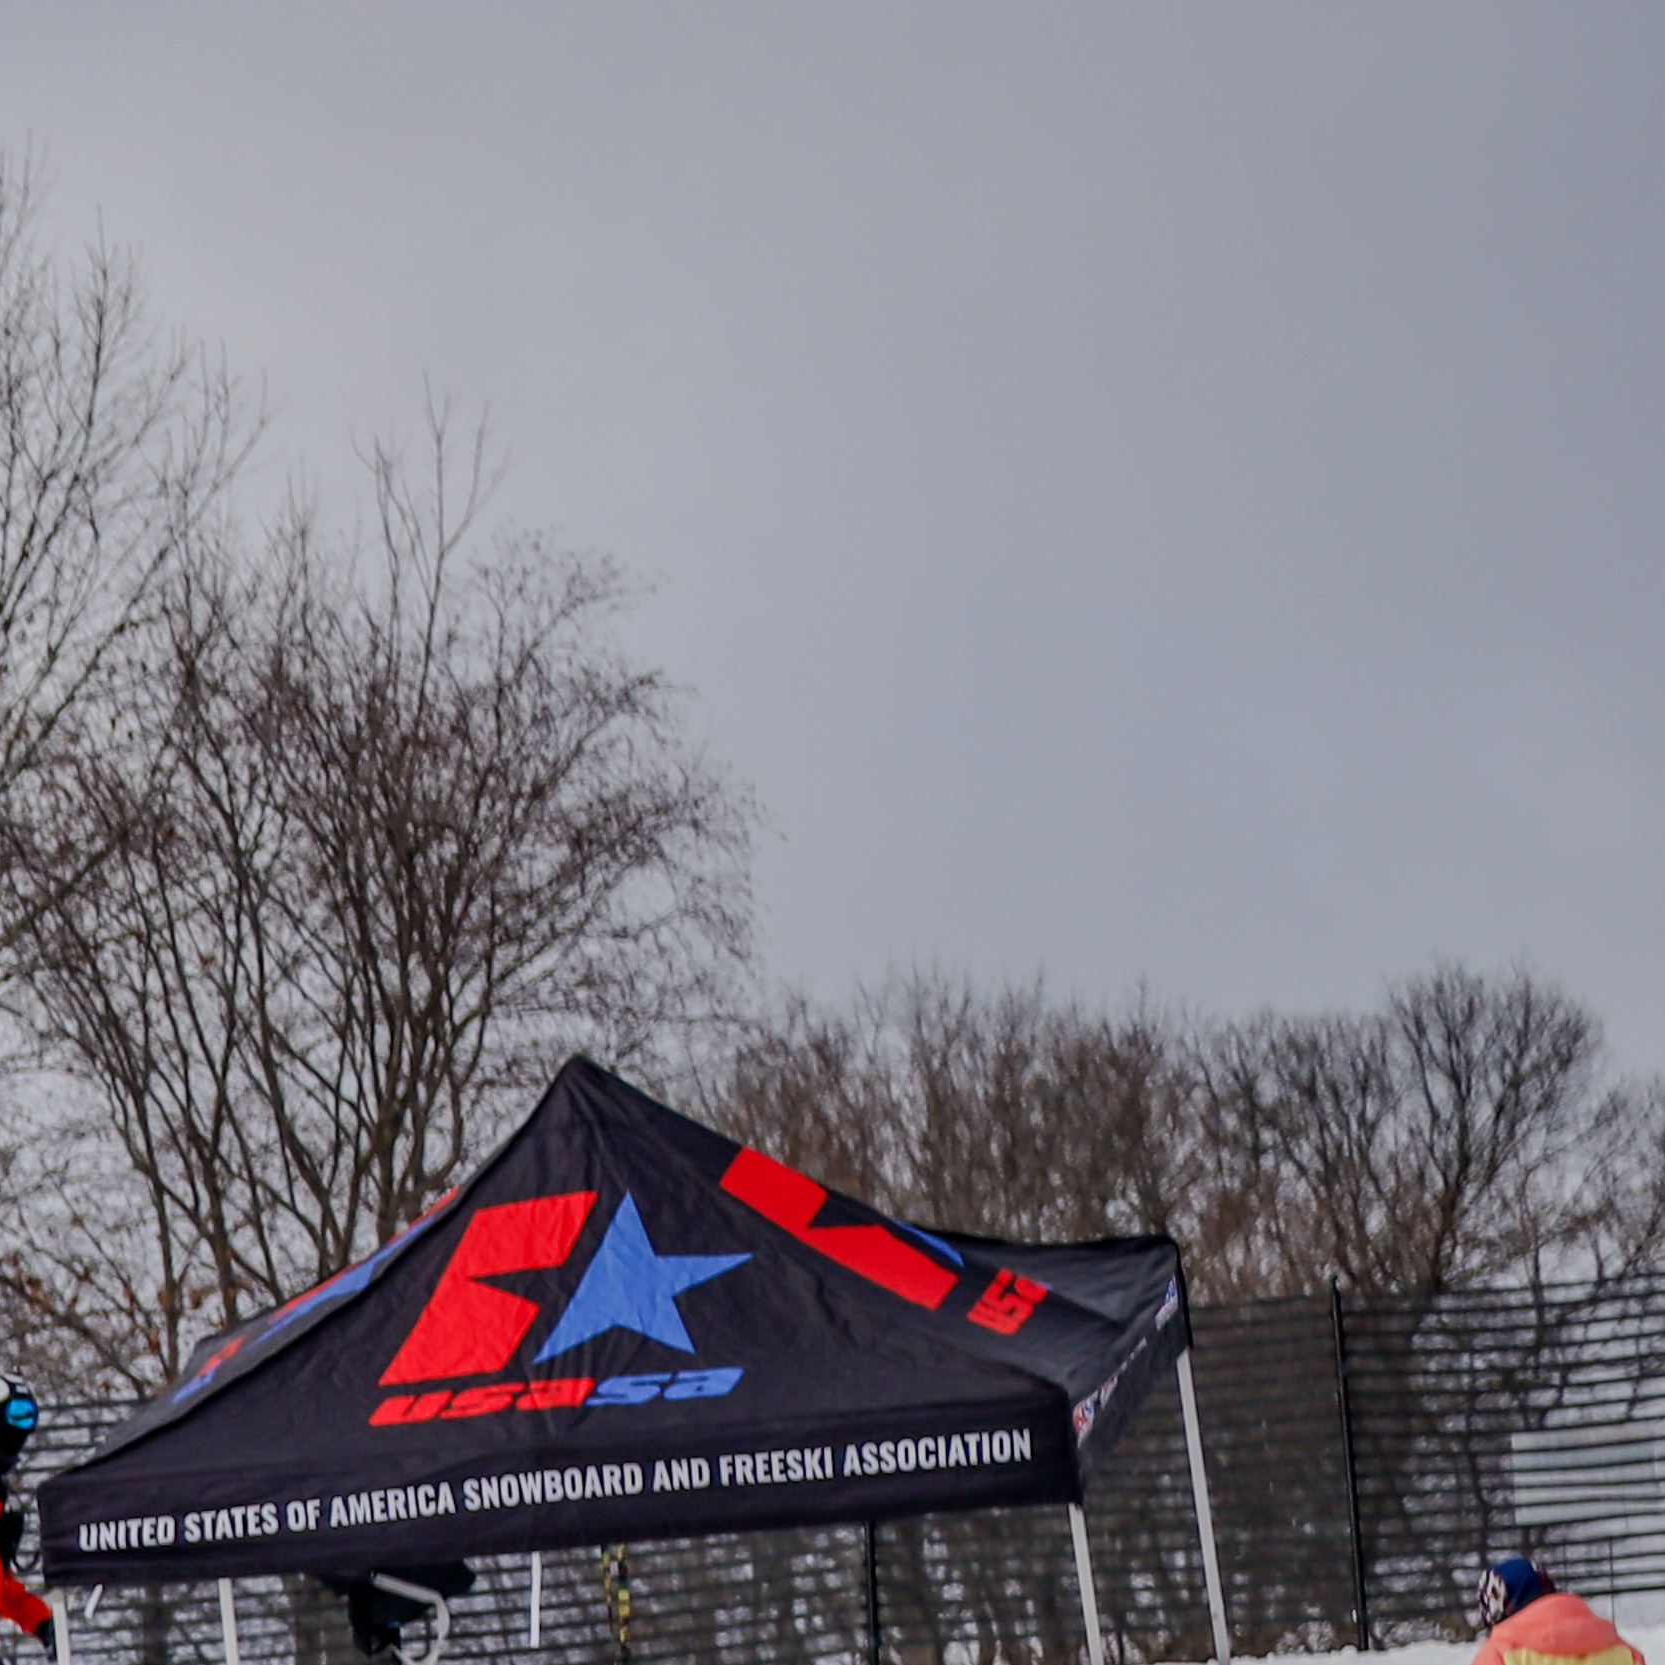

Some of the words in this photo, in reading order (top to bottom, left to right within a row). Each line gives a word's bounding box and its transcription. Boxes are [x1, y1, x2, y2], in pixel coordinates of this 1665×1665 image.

[78, 1515, 175, 1552] UNITED
[183, 1502, 279, 1543] STATES
[285, 1499, 321, 1533] OF
[329, 1482, 457, 1528] AMERICA
[462, 1462, 644, 1512] SNOWBOARD
[652, 1457, 711, 1493] AND
[718, 1446, 834, 1487] FREESKI
[843, 1428, 1032, 1477] ASSOCIATION
